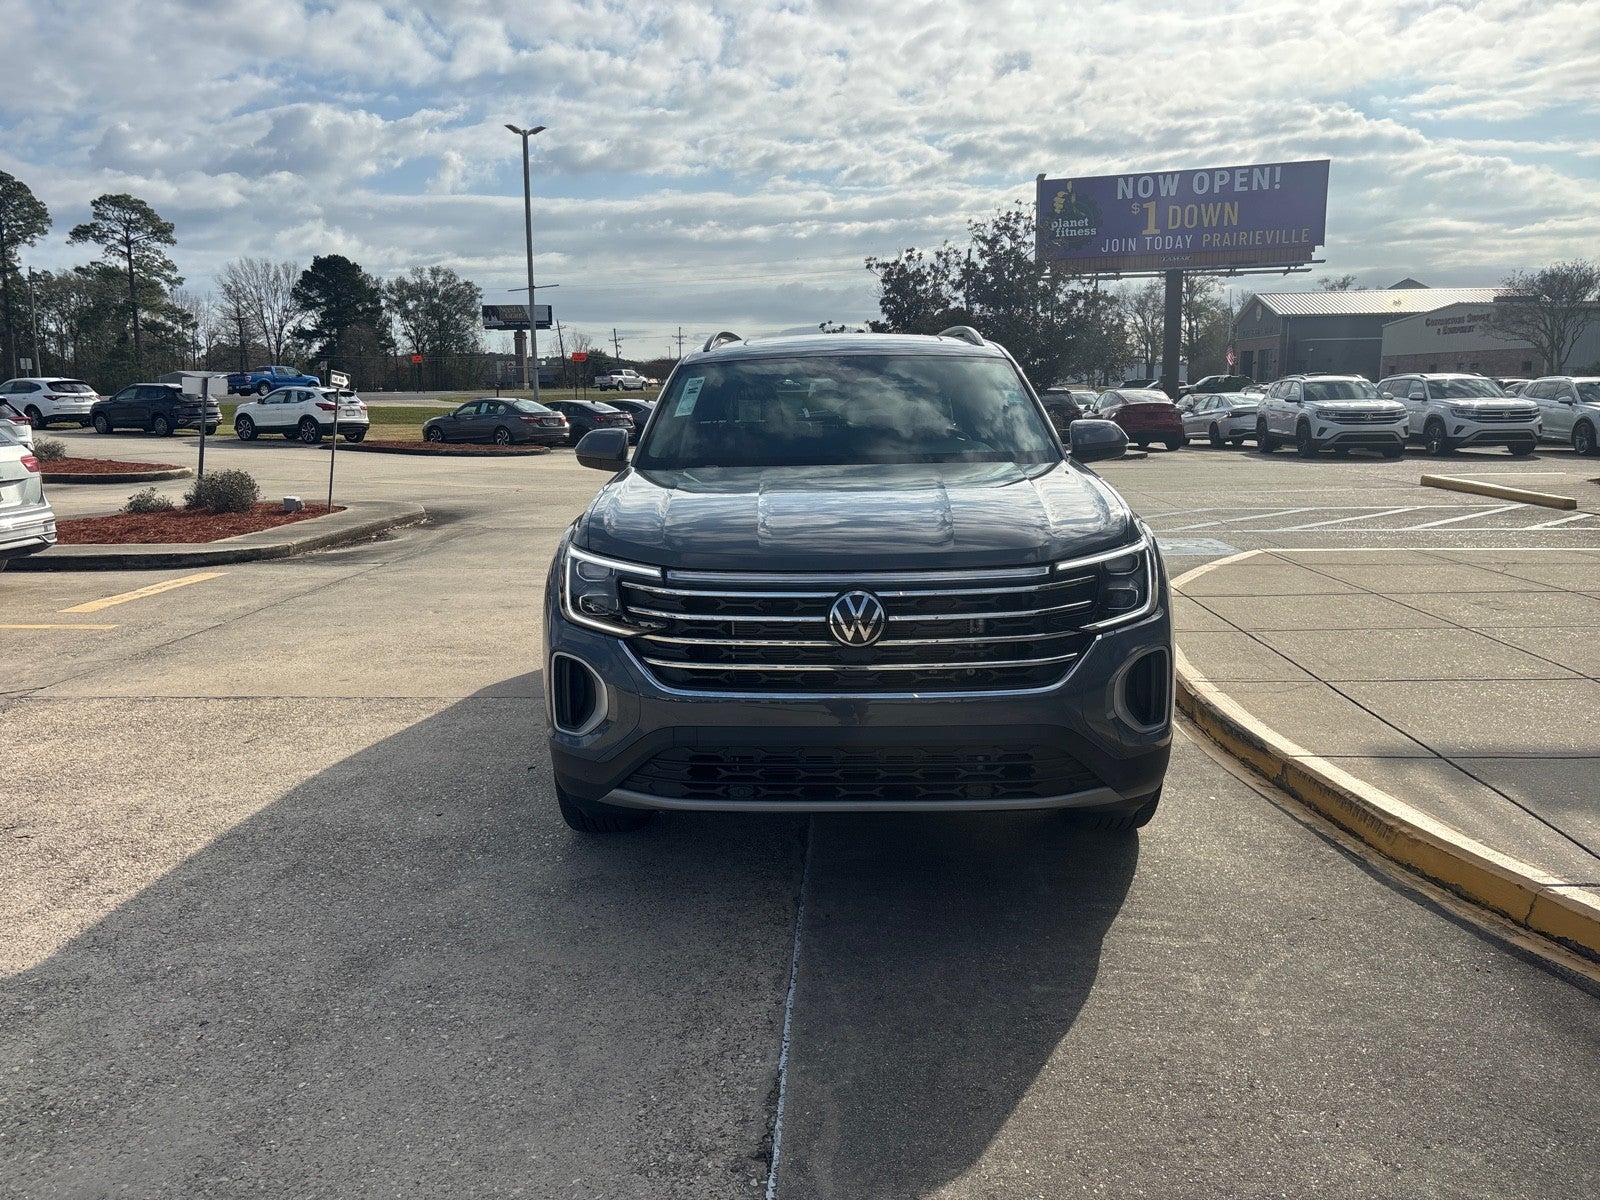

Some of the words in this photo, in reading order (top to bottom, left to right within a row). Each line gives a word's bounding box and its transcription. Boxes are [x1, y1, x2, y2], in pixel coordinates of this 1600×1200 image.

[1117, 174, 1180, 200] NOW
[1192, 166, 1282, 195] OPEN!
[1050, 217, 1089, 231] planet
[1055, 227, 1097, 238] fitness
[1131, 201, 1161, 235] $1
[1168, 201, 1239, 230] DOWN
[1101, 237, 1138, 253] JOIN
[1145, 234, 1194, 251] TODAY
[1202, 227, 1311, 248] PRAIRIEVILLE
[831, 593, 883, 644] VW
